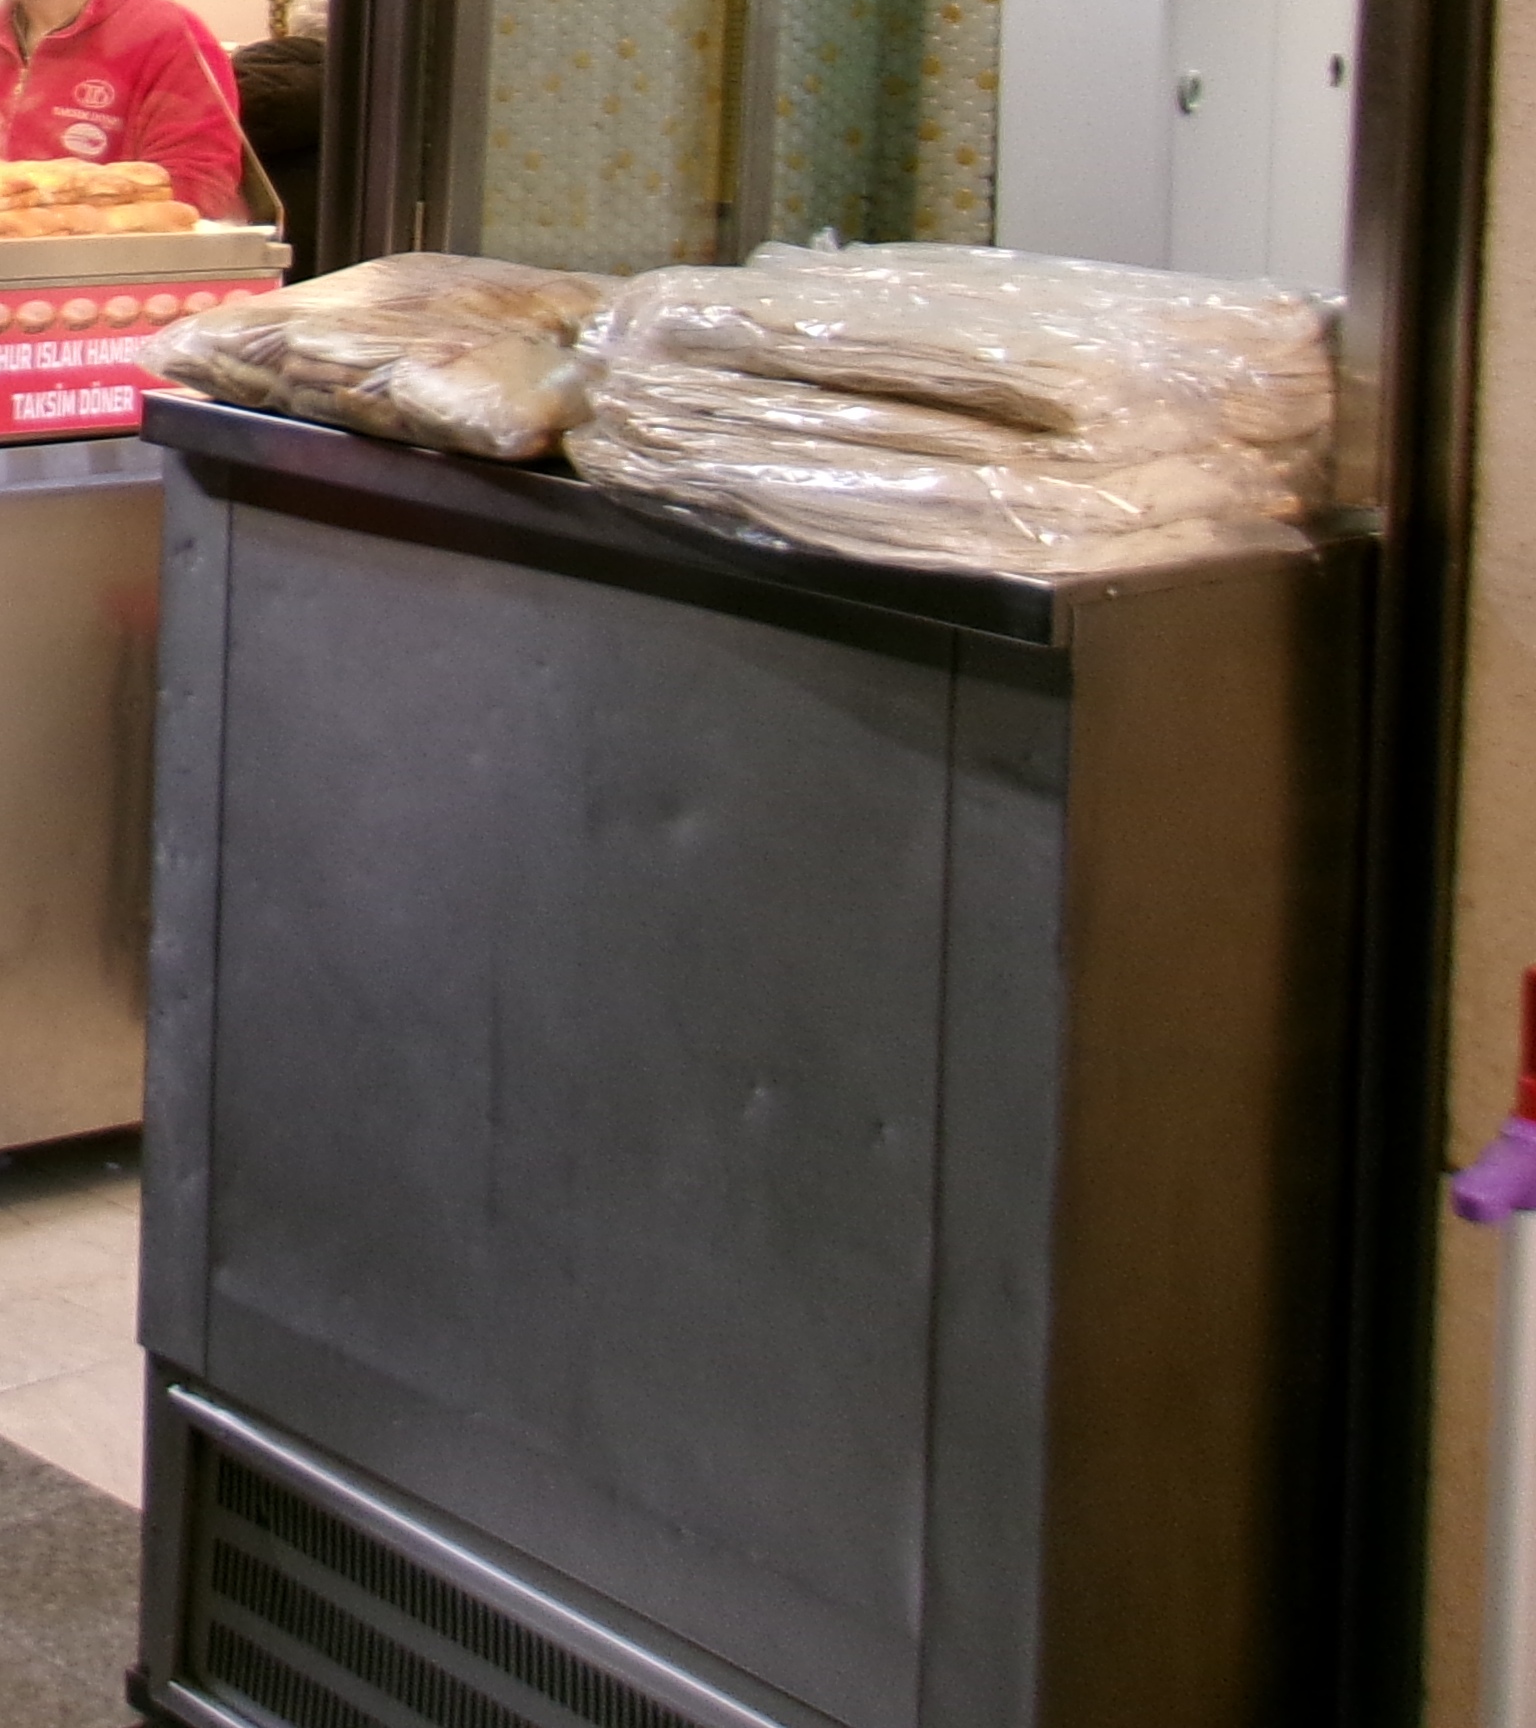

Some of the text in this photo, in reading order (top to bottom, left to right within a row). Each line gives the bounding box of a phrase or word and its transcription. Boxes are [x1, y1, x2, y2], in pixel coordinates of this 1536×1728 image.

[36, 339, 83, 369] ISLAK
[11, 381, 134, 421] TAKSİM DÖNER
